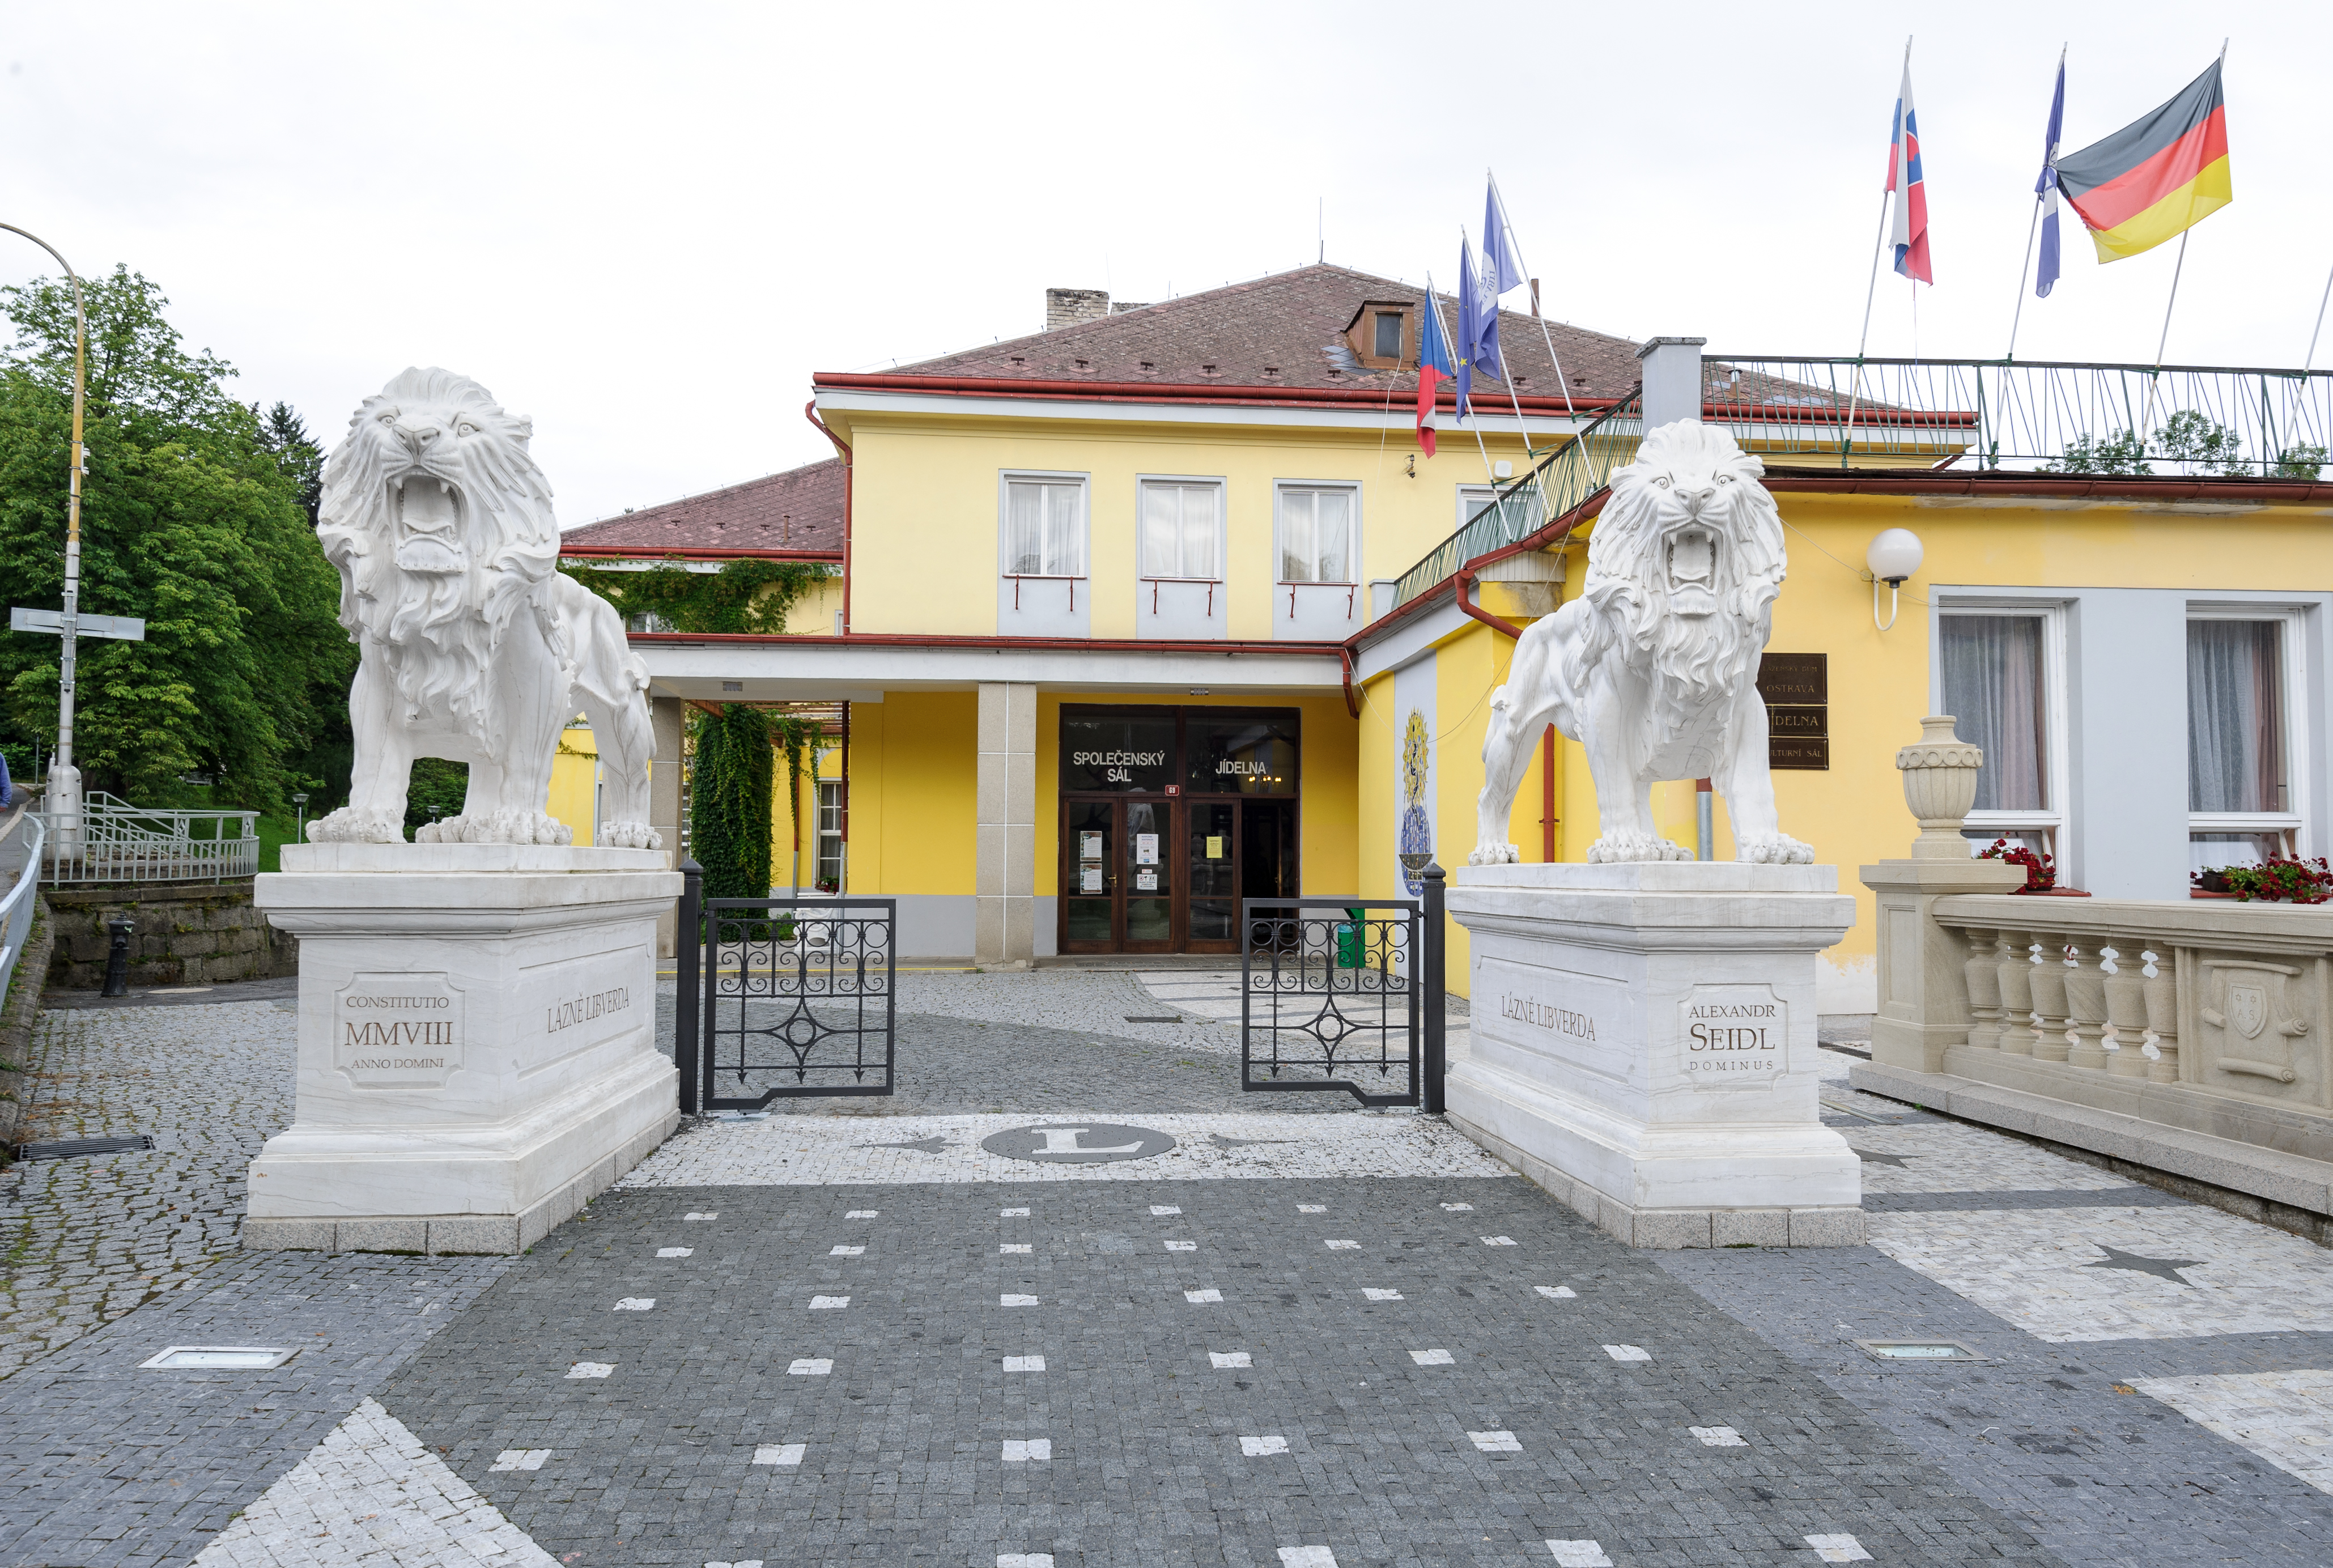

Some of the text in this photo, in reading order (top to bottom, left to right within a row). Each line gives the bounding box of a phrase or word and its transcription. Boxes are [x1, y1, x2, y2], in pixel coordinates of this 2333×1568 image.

[1802, 664, 1817, 673] DŮM
[1766, 684, 1814, 693] OSTRAVA
[1768, 709, 1819, 726] ÍDELNA
[1073, 750, 1165, 766] SPOLEČENSKÝ
[1807, 749, 1822, 757] SÁL
[1107, 766, 1132, 782] SÁL
[1215, 759, 1267, 775] JÍDELNA
[346, 996, 449, 1009] CONSTITUTIO
[547, 986, 630, 1034] LÁZNĚ LIBVERDA
[1501, 991, 1596, 1042] LÁZNĚ LIBVERDA
[1689, 1005, 1776, 1018] ALEXANDR
[344, 1022, 453, 1046] MMVIII
[1689, 1023, 1775, 1051] SEIDL
[351, 1058, 444, 1069] ANNO DOMINI
[1690, 1060, 1773, 1070] DOMINUS
[1030, 1128, 1145, 1154] L
